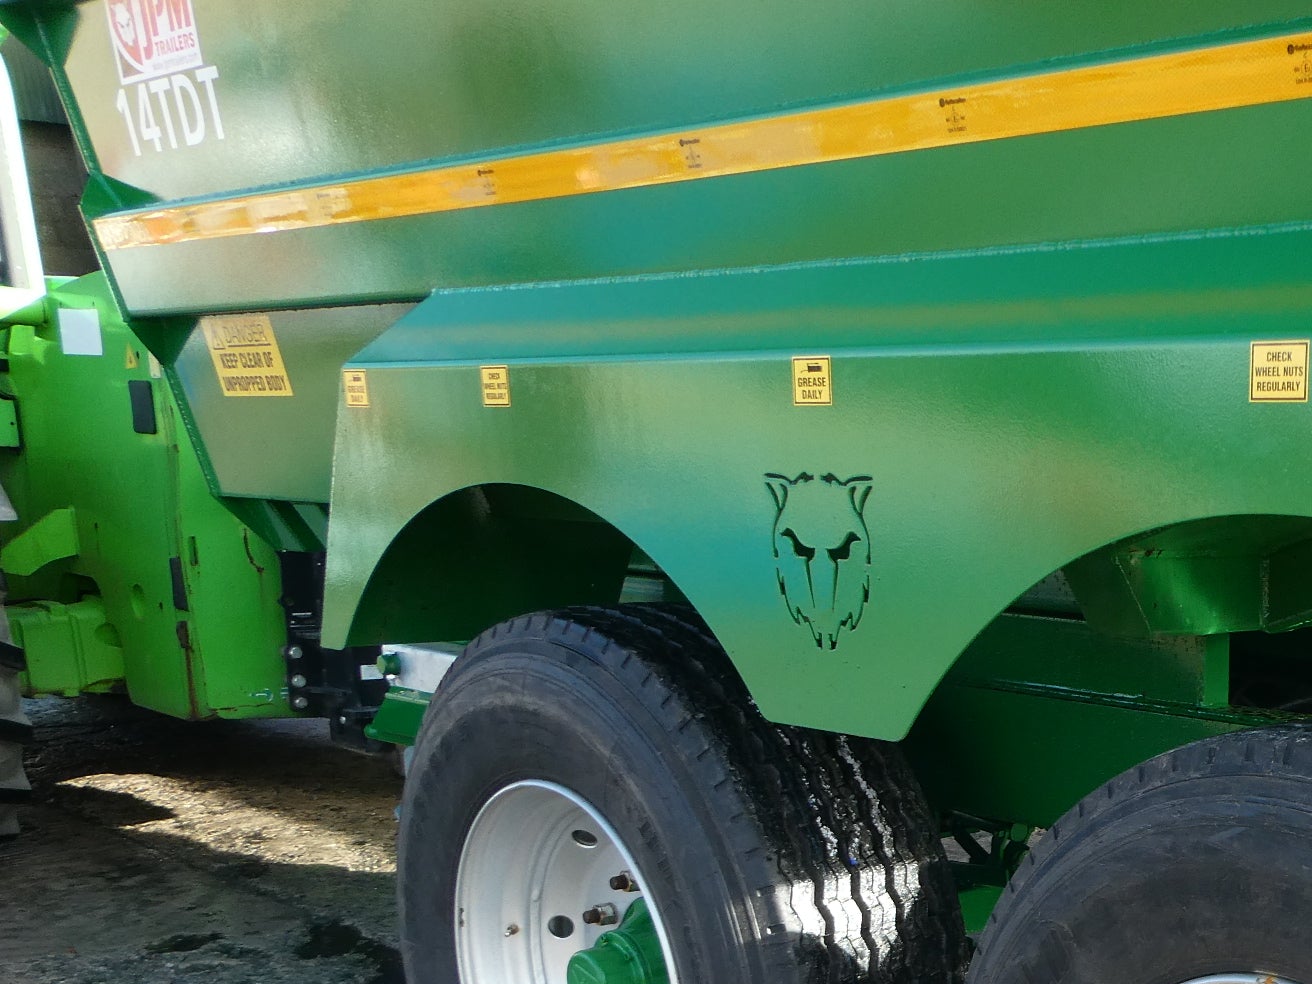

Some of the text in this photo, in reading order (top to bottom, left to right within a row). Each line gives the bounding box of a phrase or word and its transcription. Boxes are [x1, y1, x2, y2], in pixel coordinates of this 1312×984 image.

[154, 32, 196, 57] TRAILERS
[116, 65, 225, 157] 14TDT
[222, 323, 269, 344] DANGER
[219, 351, 274, 369] KEEP CLEAR OF
[1266, 351, 1293, 363] CHECK
[1255, 366, 1304, 377] WHEEL NUTS
[222, 374, 287, 392] UNPROPPED BODY
[797, 377, 827, 388] GREASE
[1256, 381, 1301, 392] REGULARLY
[801, 389, 823, 400] DAILY
